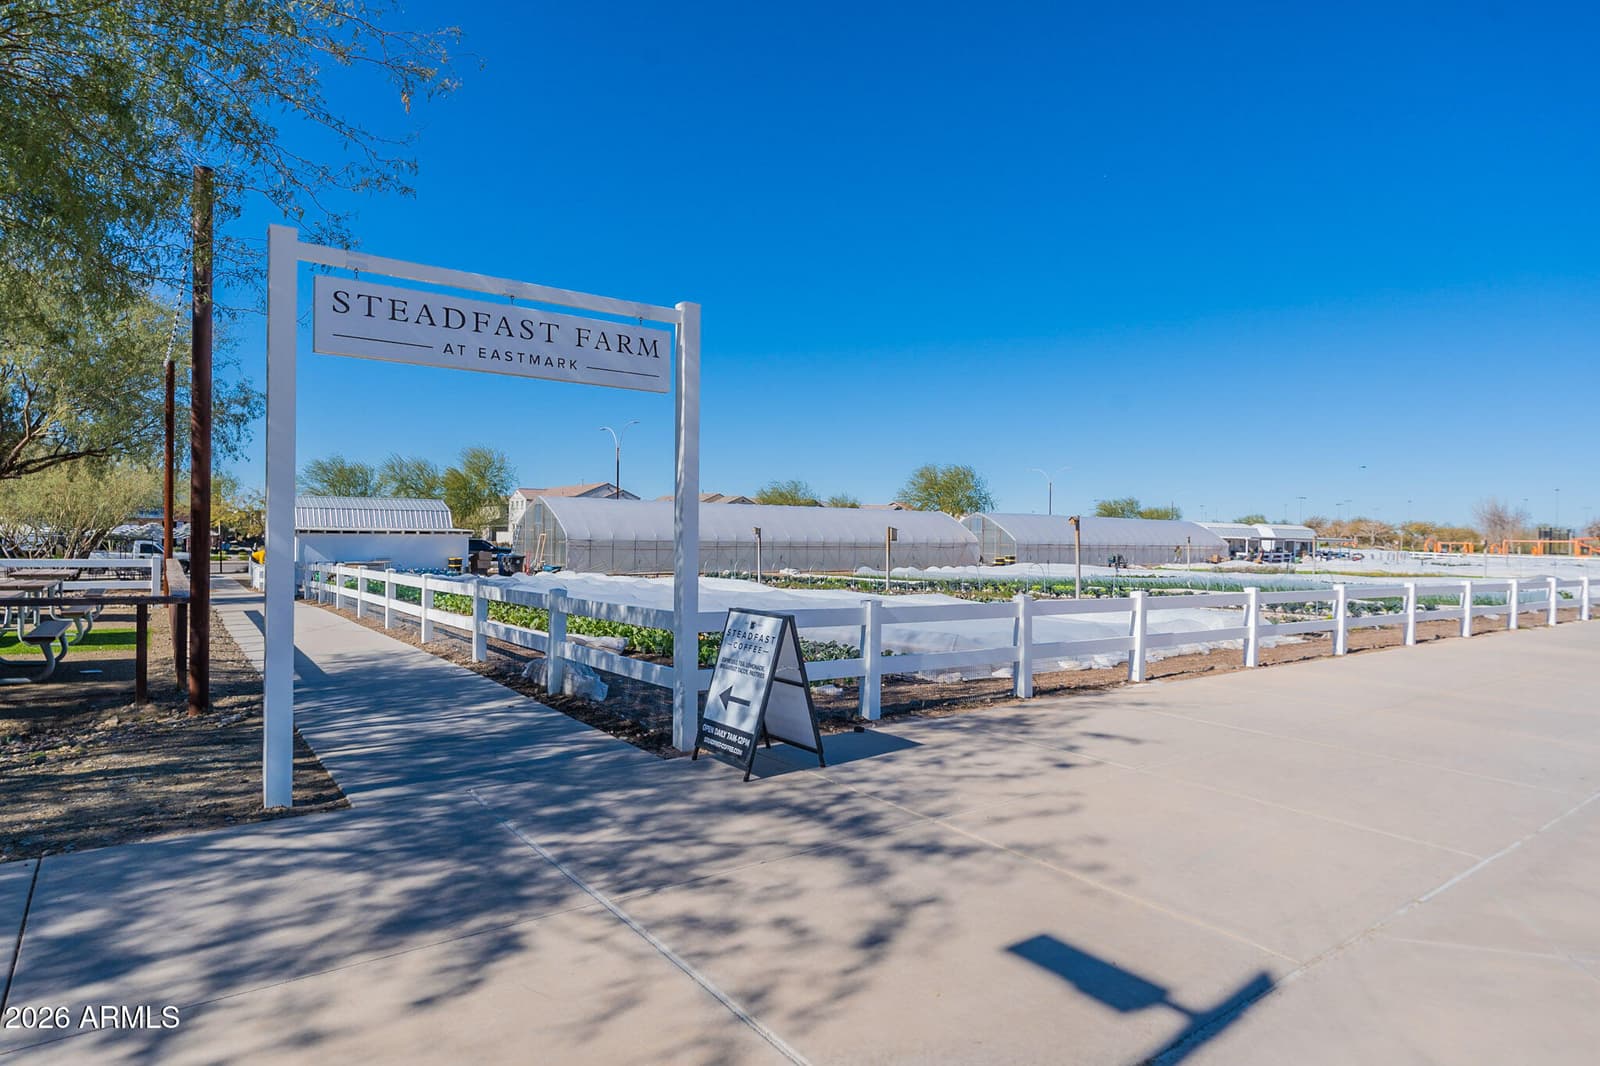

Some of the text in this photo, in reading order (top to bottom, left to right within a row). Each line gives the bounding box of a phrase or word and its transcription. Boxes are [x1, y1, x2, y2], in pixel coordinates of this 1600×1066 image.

[332, 289, 660, 358] STEADFAST FARM
[443, 343, 578, 370] AT EASTMARK
[726, 628, 776, 644] STEADFAST
[733, 641, 762, 653] COFFEE
[714, 727, 727, 738] DAILY
